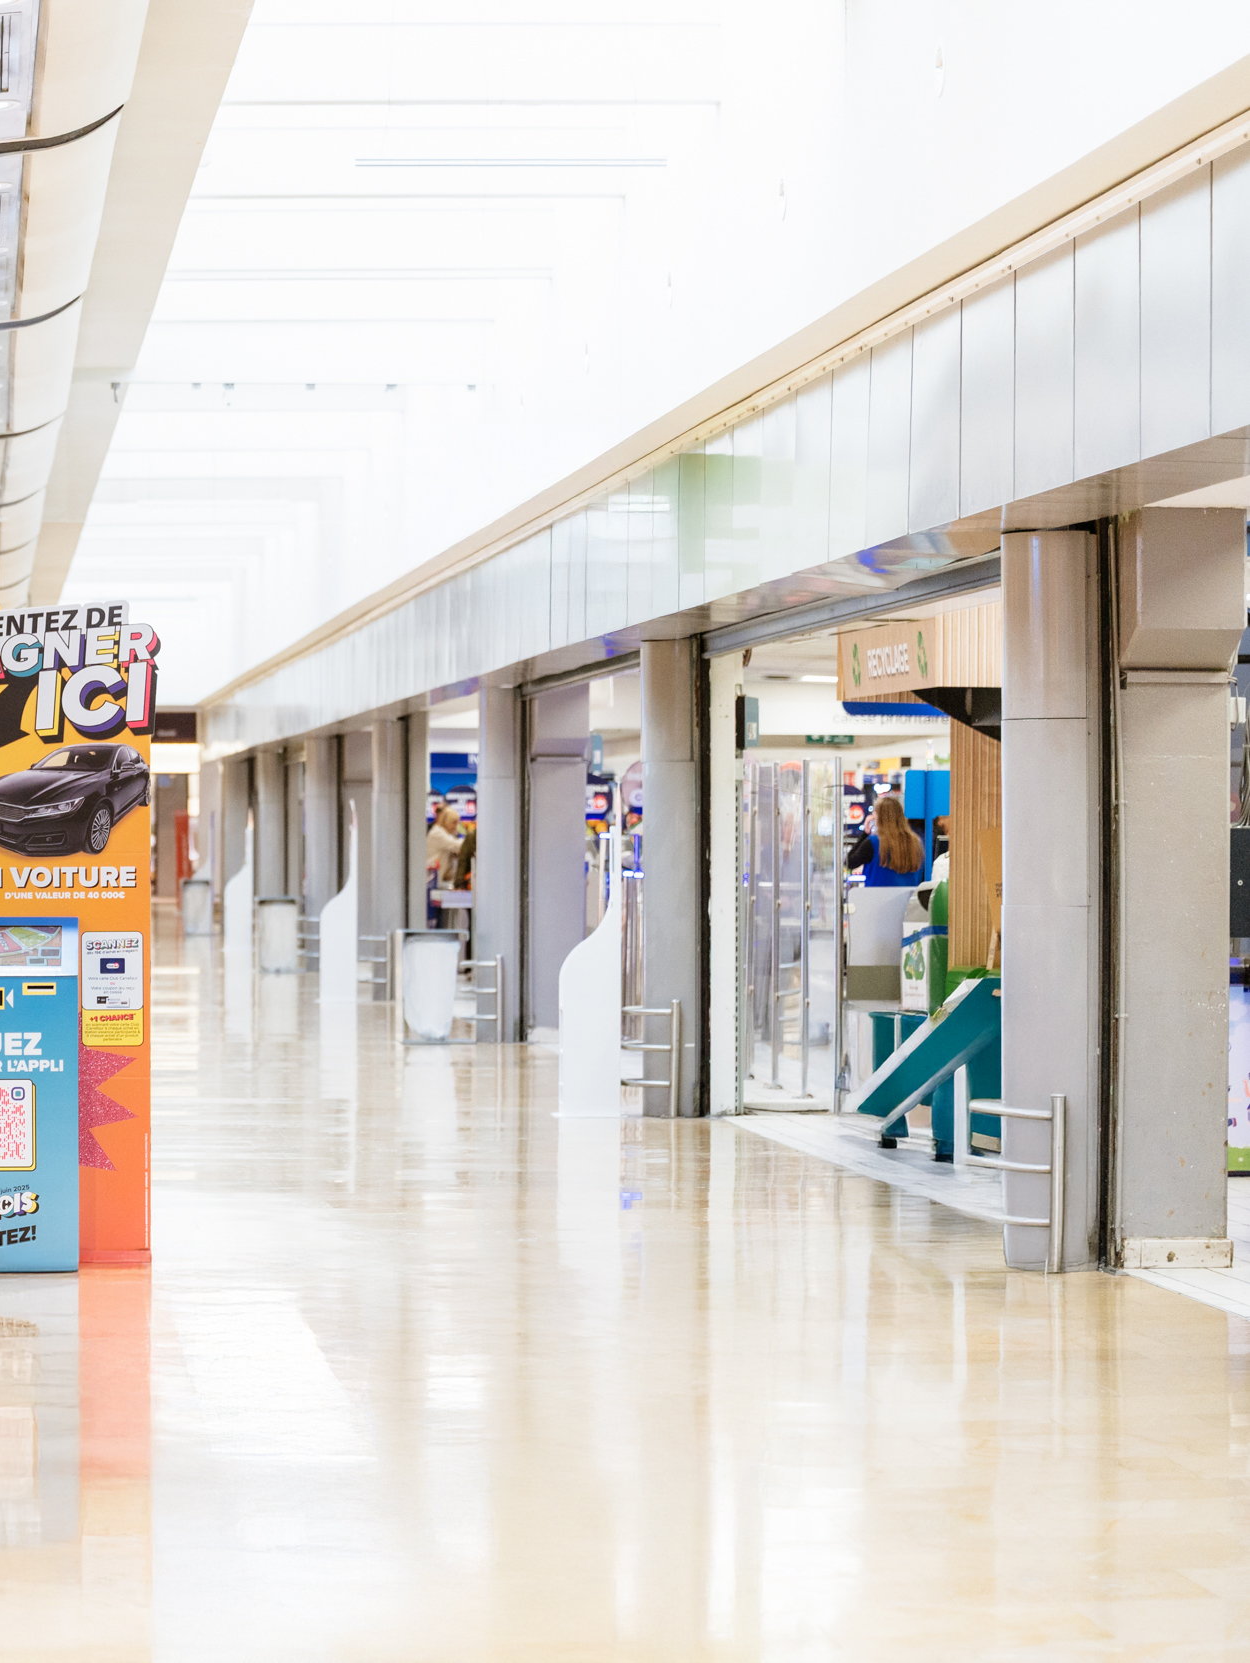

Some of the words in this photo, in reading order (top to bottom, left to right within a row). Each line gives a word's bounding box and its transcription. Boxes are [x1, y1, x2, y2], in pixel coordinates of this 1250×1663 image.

[86, 606, 122, 628] DE
[867, 643, 909, 678] RECYCLAGE
[35, 662, 150, 737] ICI
[9, 866, 136, 889] VOITURE
[4, 892, 33, 900] D'UNE
[35, 891, 71, 899] VALEUR
[73, 891, 86, 899] DE
[87, 891, 100, 899] 40
[101, 891, 125, 899] 000€
[86, 938, 139, 951] SCANNEZ
[7, 1059, 64, 1072] L'APPLI
[0, 1187, 11, 1195] juin
[13, 1184, 30, 1192] 2025
